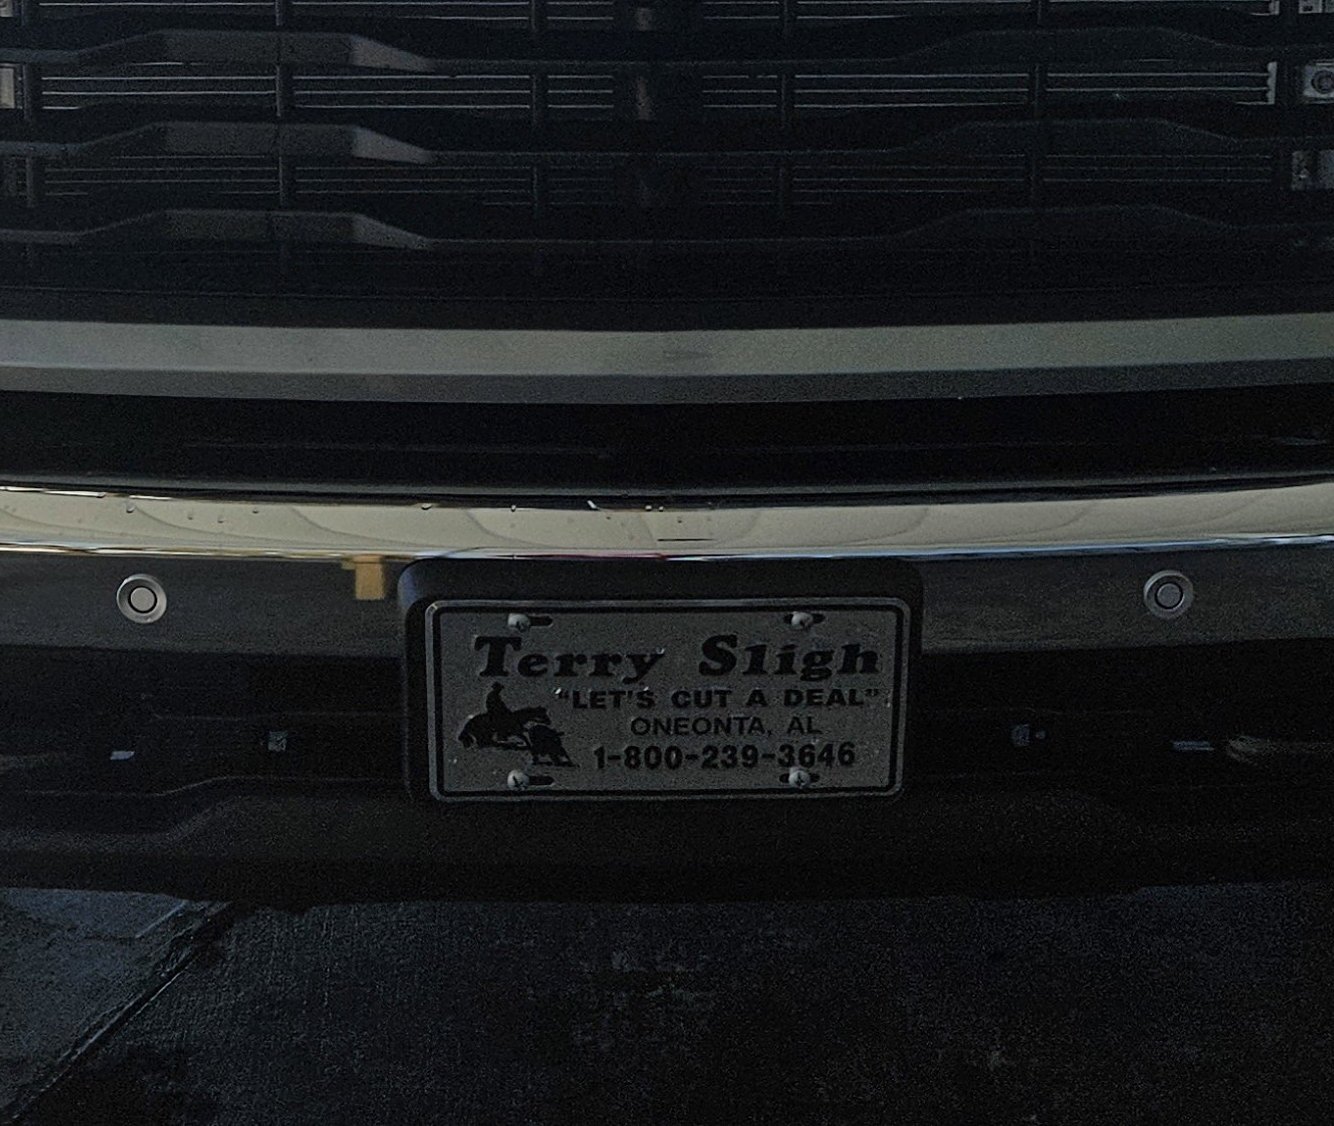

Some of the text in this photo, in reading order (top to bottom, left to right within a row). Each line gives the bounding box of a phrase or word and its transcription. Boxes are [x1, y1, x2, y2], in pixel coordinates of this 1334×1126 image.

[474, 633, 880, 685] Terry Sligh
[671, 688, 732, 709] CUT
[745, 688, 767, 708] A
[630, 716, 823, 737] ONEONTA, AL
[593, 742, 857, 771] 1-800-239-3646
